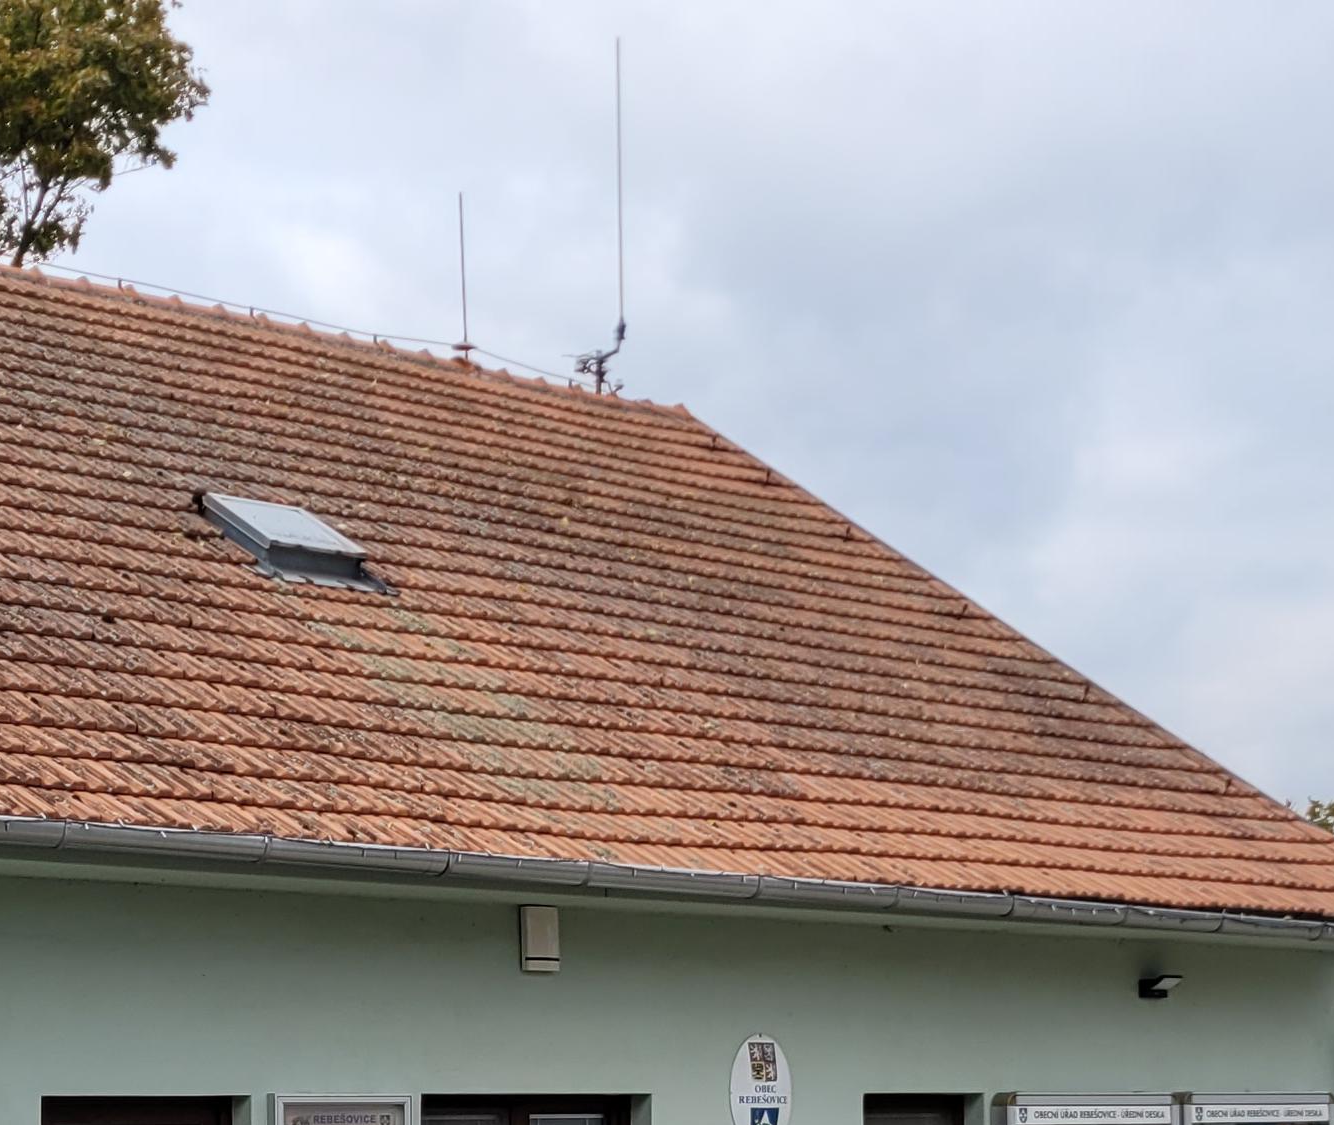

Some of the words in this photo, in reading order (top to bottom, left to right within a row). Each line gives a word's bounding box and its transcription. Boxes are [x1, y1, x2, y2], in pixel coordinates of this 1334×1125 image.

[754, 1084, 777, 1093] OBEC
[738, 1094, 787, 1104] REBEŠOVICE
[313, 1112, 377, 1124] REBEŠOVICE
[1079, 1108, 1117, 1119] REBEŠOVICE
[1145, 1110, 1165, 1119] DESKA
